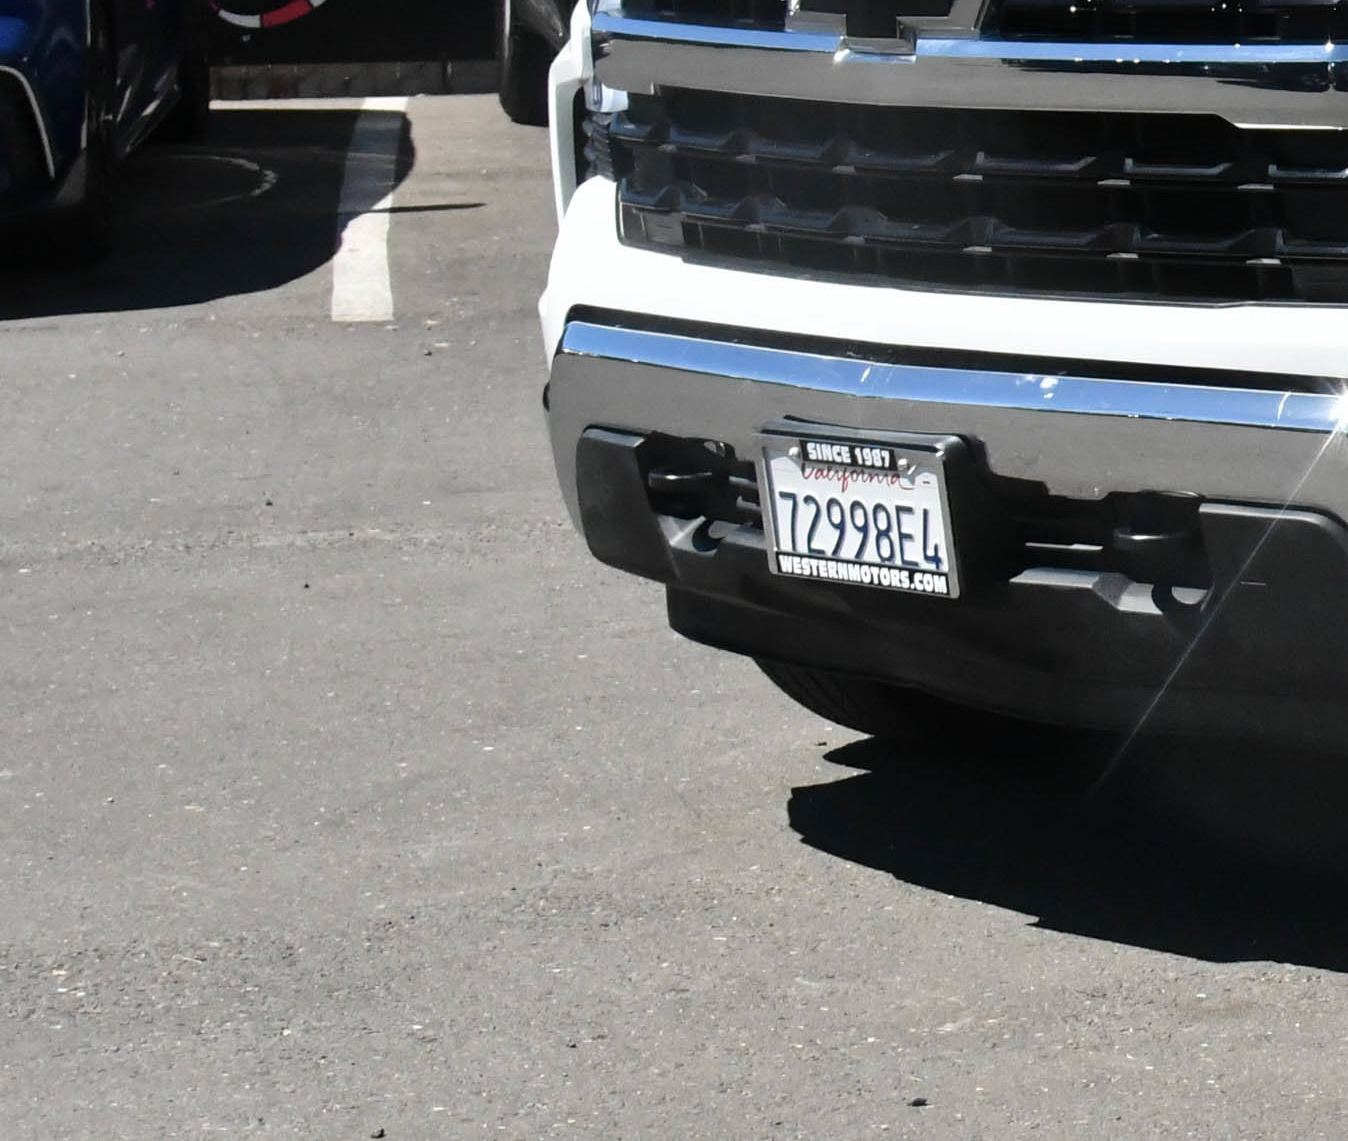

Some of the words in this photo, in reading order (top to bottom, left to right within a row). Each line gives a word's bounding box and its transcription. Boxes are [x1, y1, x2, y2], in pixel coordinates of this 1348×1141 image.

[806, 442, 850, 464] SINCE
[854, 449, 890, 468] 1987
[778, 490, 943, 570] 72998E4
[778, 555, 948, 594] WESTERNMOTORS.COM
